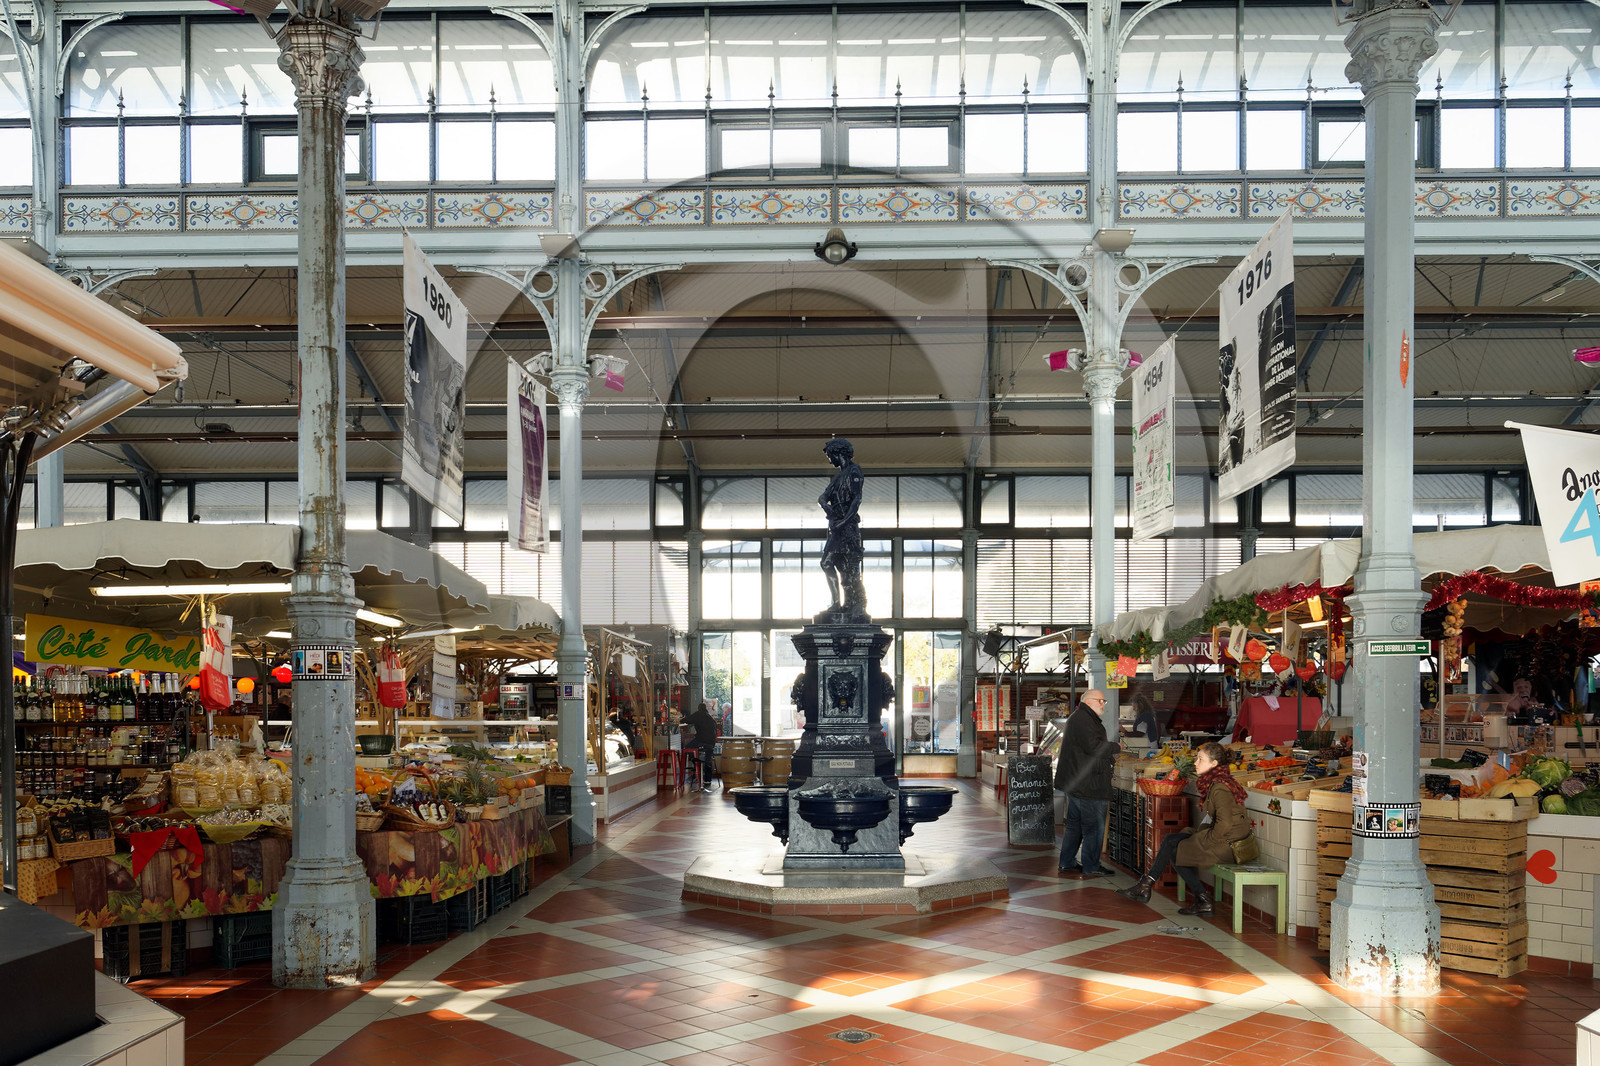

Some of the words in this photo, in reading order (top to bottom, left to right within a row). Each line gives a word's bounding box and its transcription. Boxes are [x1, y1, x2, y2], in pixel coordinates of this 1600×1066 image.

[1238, 250, 1272, 306] 1976
[423, 275, 453, 330] 1980
[1143, 360, 1164, 396] 1984
[37, 624, 111, 660] Côté
[1010, 776, 1047, 789] Bananes
[1016, 761, 1037, 774] Bio
